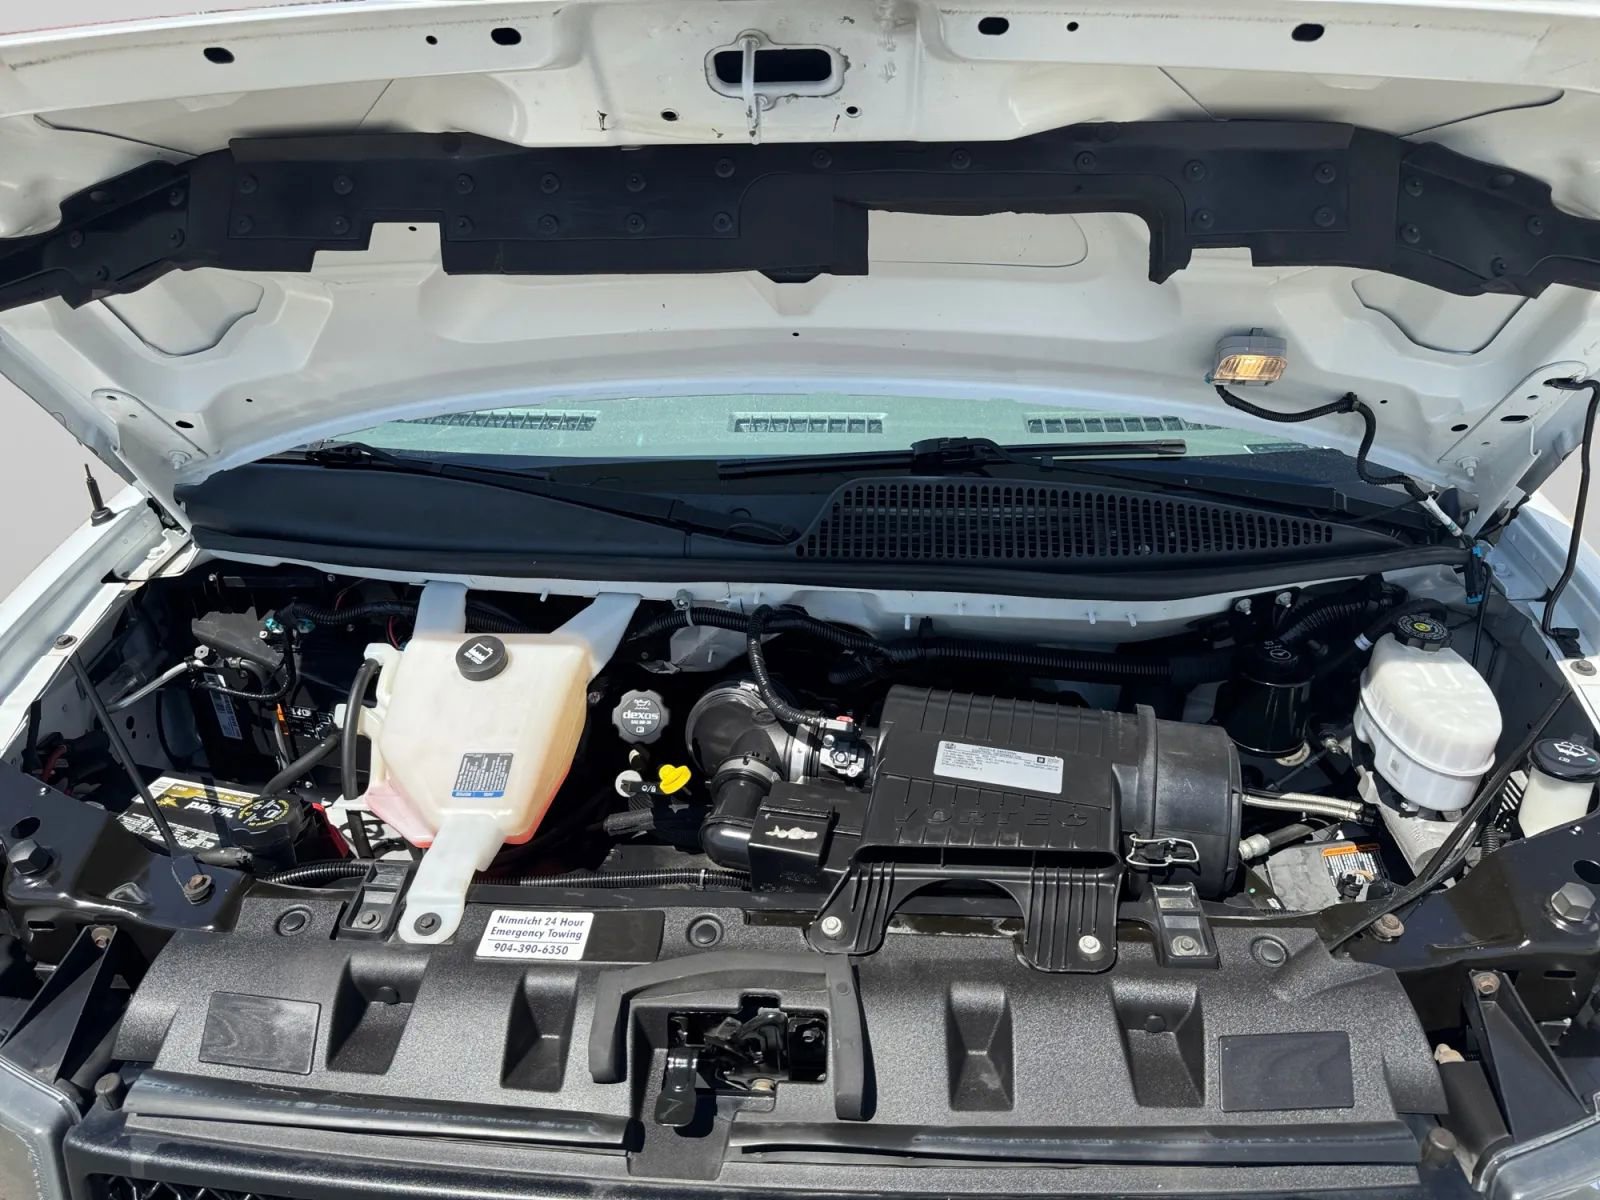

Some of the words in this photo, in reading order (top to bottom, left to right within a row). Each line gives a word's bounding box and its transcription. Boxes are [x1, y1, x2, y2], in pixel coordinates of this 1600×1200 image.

[622, 709, 659, 720] dexos
[894, 808, 1088, 827] VORTEC
[497, 915, 542, 926] Nimnicht
[544, 917, 557, 926] 24
[560, 918, 585, 927] Hour
[490, 926, 544, 939] Emergency
[548, 929, 583, 941] Towing
[494, 943, 568, 955] 904-390-6350
